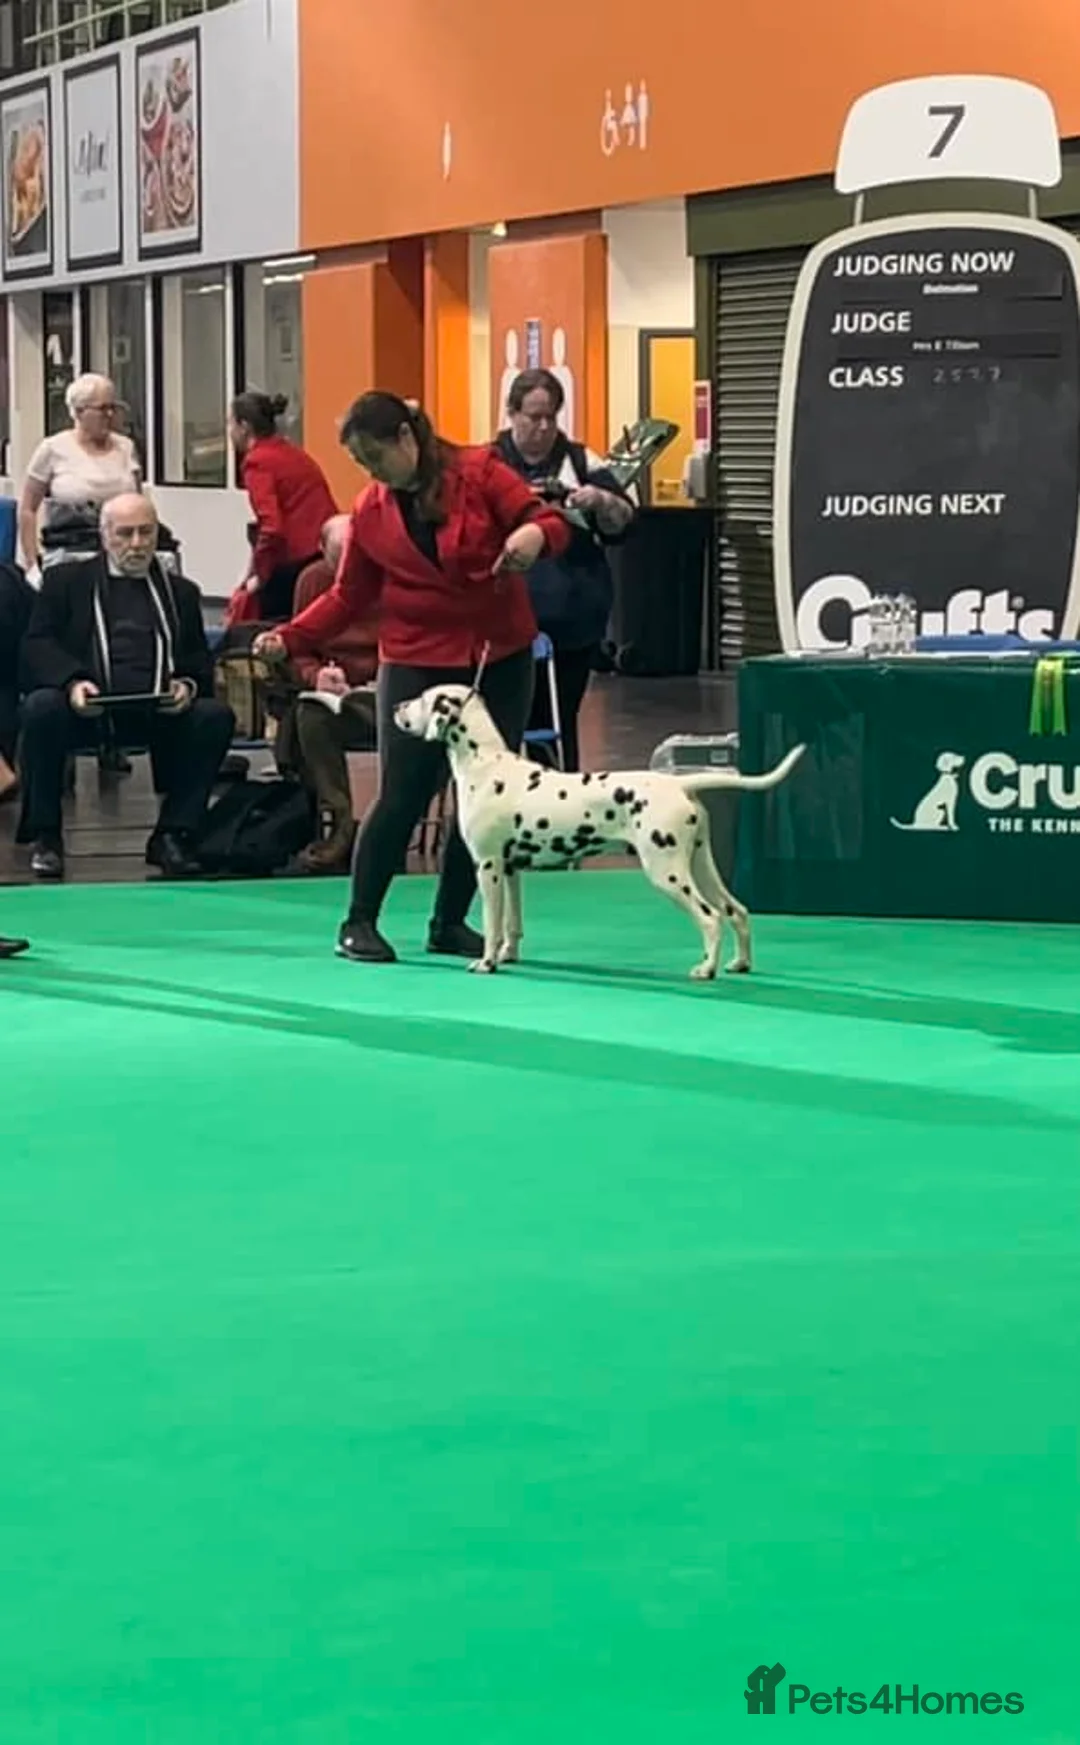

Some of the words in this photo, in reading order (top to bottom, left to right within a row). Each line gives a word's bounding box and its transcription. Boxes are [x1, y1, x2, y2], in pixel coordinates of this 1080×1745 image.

[927, 104, 966, 158] 7
[834, 253, 943, 277] JUDGING
[951, 251, 1015, 273] NOW
[831, 311, 912, 334] JUDGE
[828, 366, 905, 388] CLASS
[821, 494, 933, 517] JUDGING
[941, 493, 1006, 515] NEXT
[797, 574, 1054, 649] Cfts
[988, 817, 1023, 832] THE
